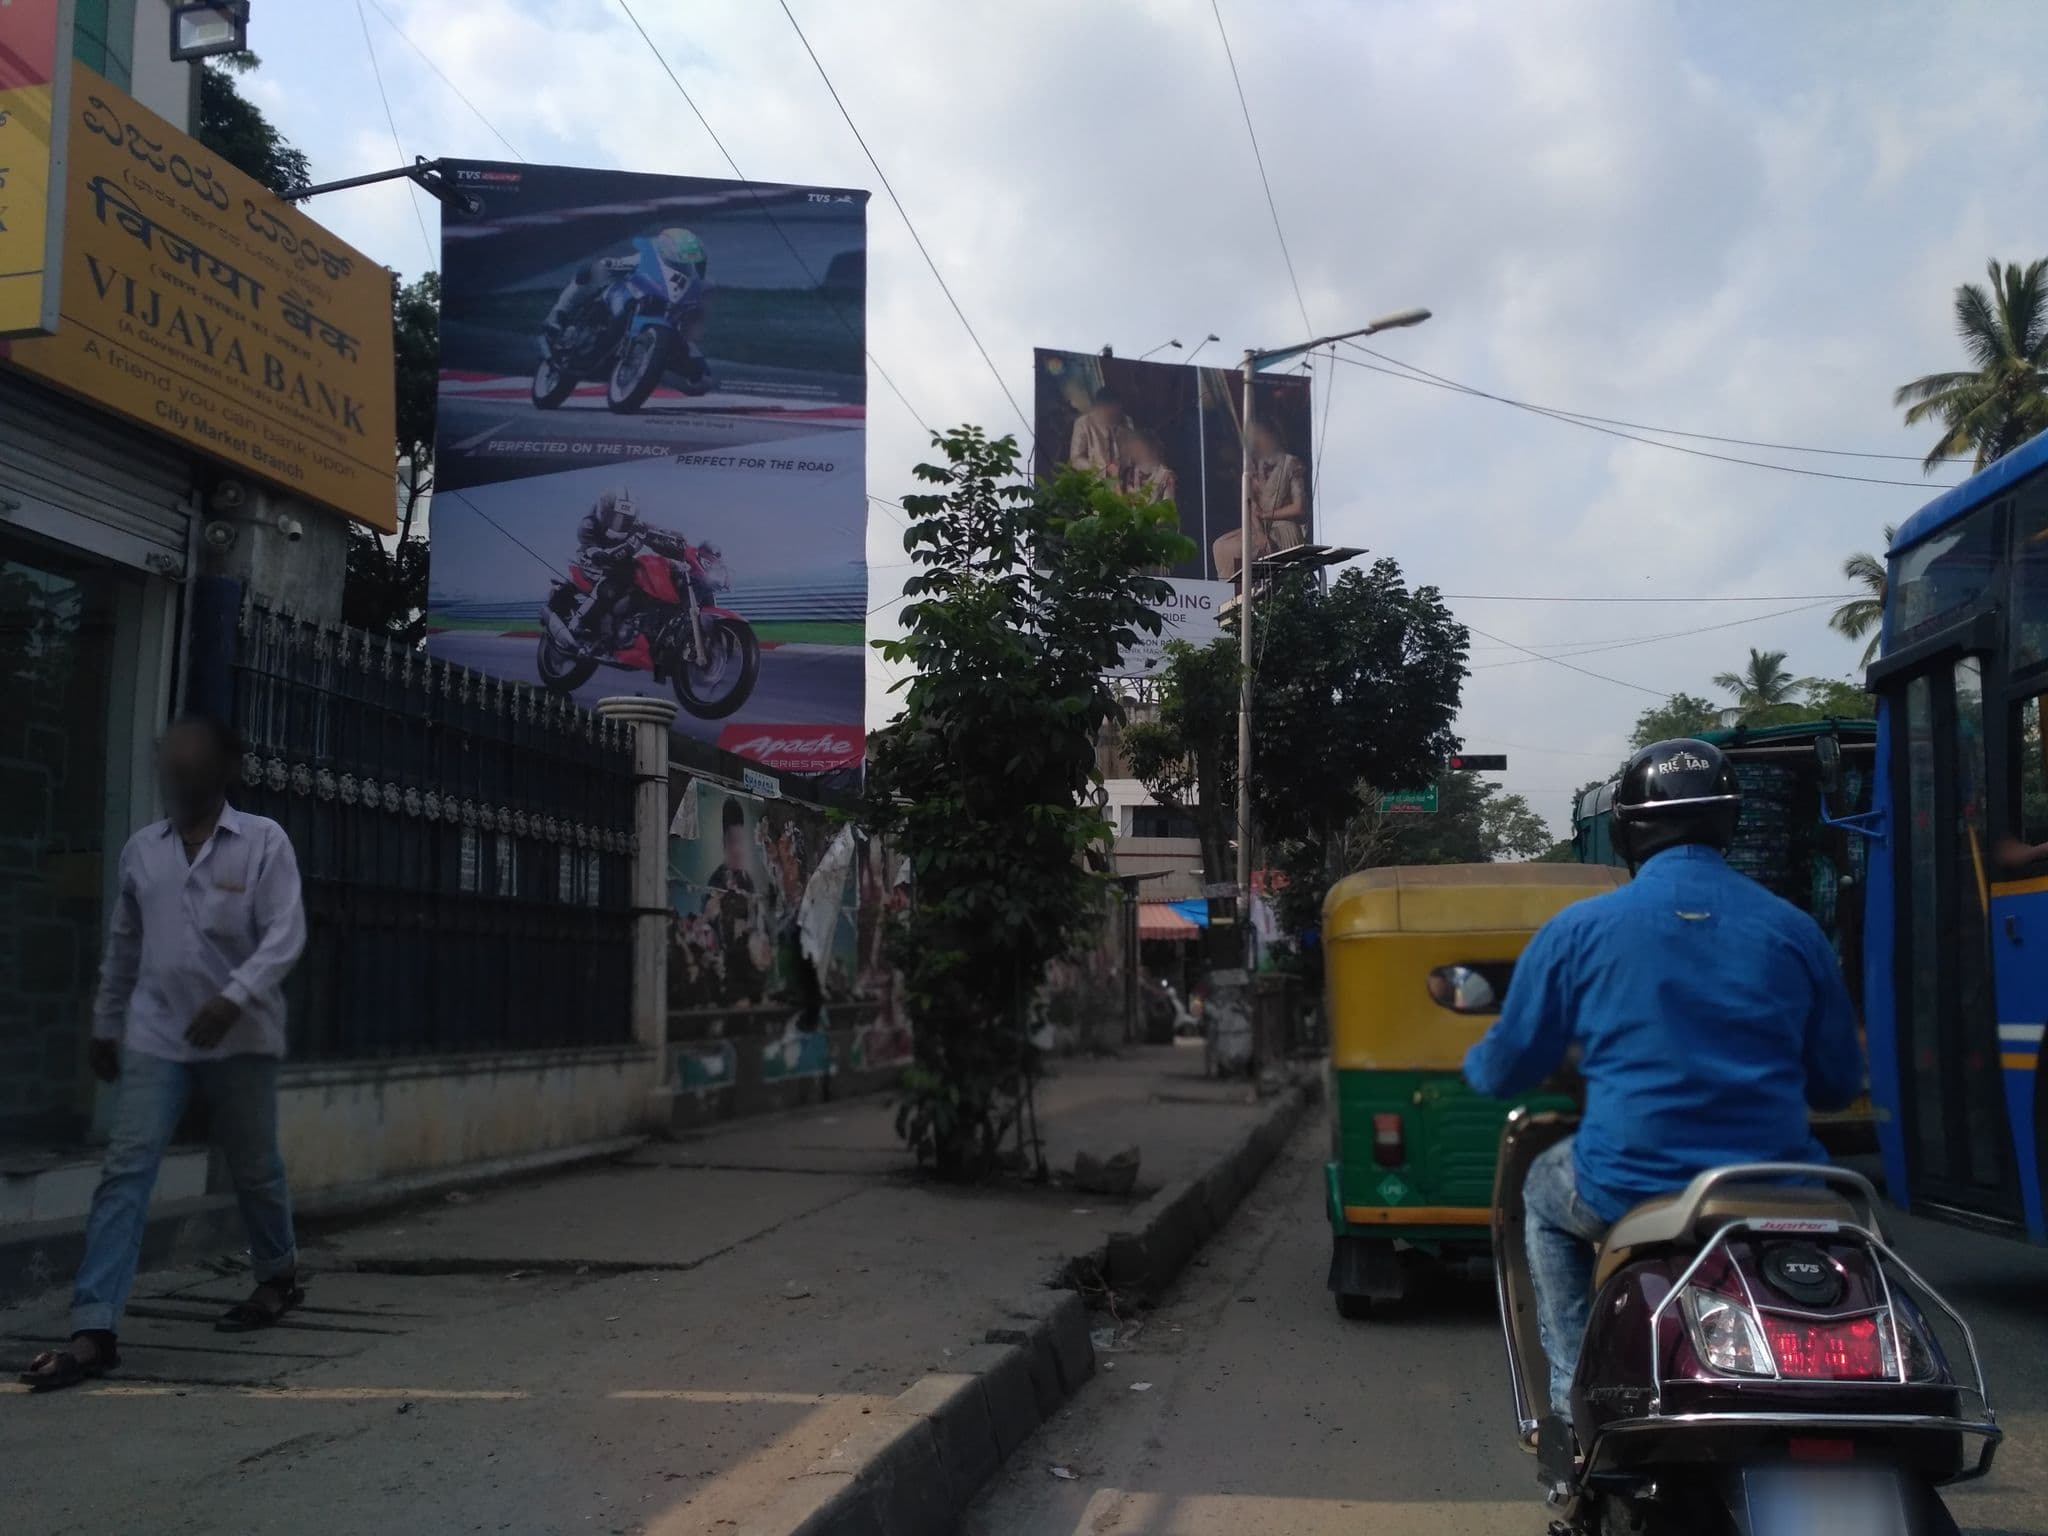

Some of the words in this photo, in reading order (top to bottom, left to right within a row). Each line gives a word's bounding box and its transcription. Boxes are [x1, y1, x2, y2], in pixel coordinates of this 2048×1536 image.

[83, 96, 229, 211] ವಿಜಯ
[456, 169, 481, 181] TVS
[807, 192, 831, 204] TVS
[86, 175, 266, 312] विजया
[277, 287, 362, 365] बैंक
[83, 252, 250, 377] VIJAYA
[263, 350, 367, 437] BANK
[84, 338, 102, 361] A
[109, 348, 172, 394] friend
[177, 384, 217, 414] you
[221, 406, 257, 432] can
[262, 425, 306, 457] bank
[311, 450, 356, 480] upon
[155, 399, 190, 431] City
[193, 415, 249, 455] Market
[251, 442, 305, 481] Branch
[488, 440, 568, 454] PERFECTED
[572, 442, 593, 455] ON
[597, 443, 621, 455] THE
[625, 444, 671, 457] TRACK
[676, 454, 737, 468] PERFECT
[738, 457, 767, 470] FOR
[770, 459, 795, 471] THE
[796, 460, 835, 473] ROAD
[732, 734, 852, 758] Apache
[1785, 1262, 1820, 1273] TVS
